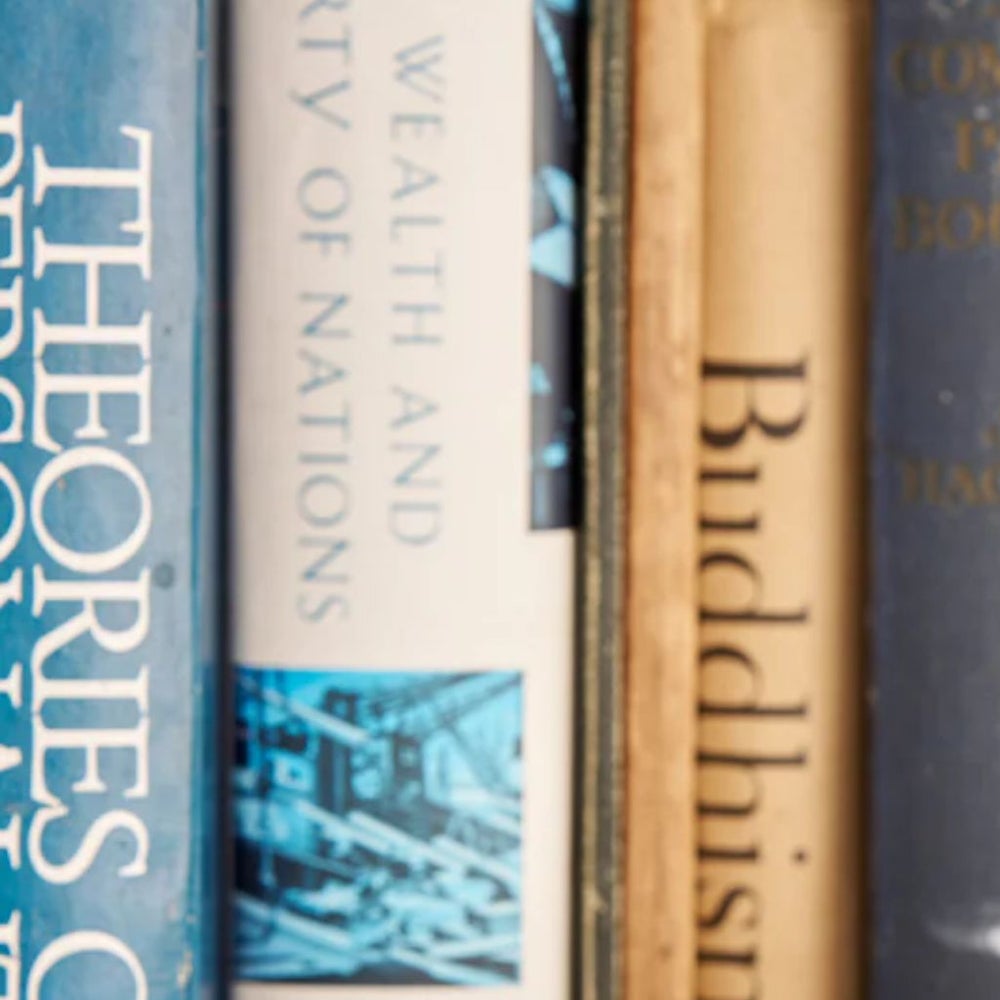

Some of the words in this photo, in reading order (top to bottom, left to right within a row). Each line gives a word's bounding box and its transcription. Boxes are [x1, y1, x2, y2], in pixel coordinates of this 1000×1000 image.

[297, 166, 353, 258] OF
[390, 33, 446, 346] WEALTH
[28, 124, 153, 885] THEORIES
[296, 290, 352, 624] NATIONS
[389, 384, 442, 547] AND
